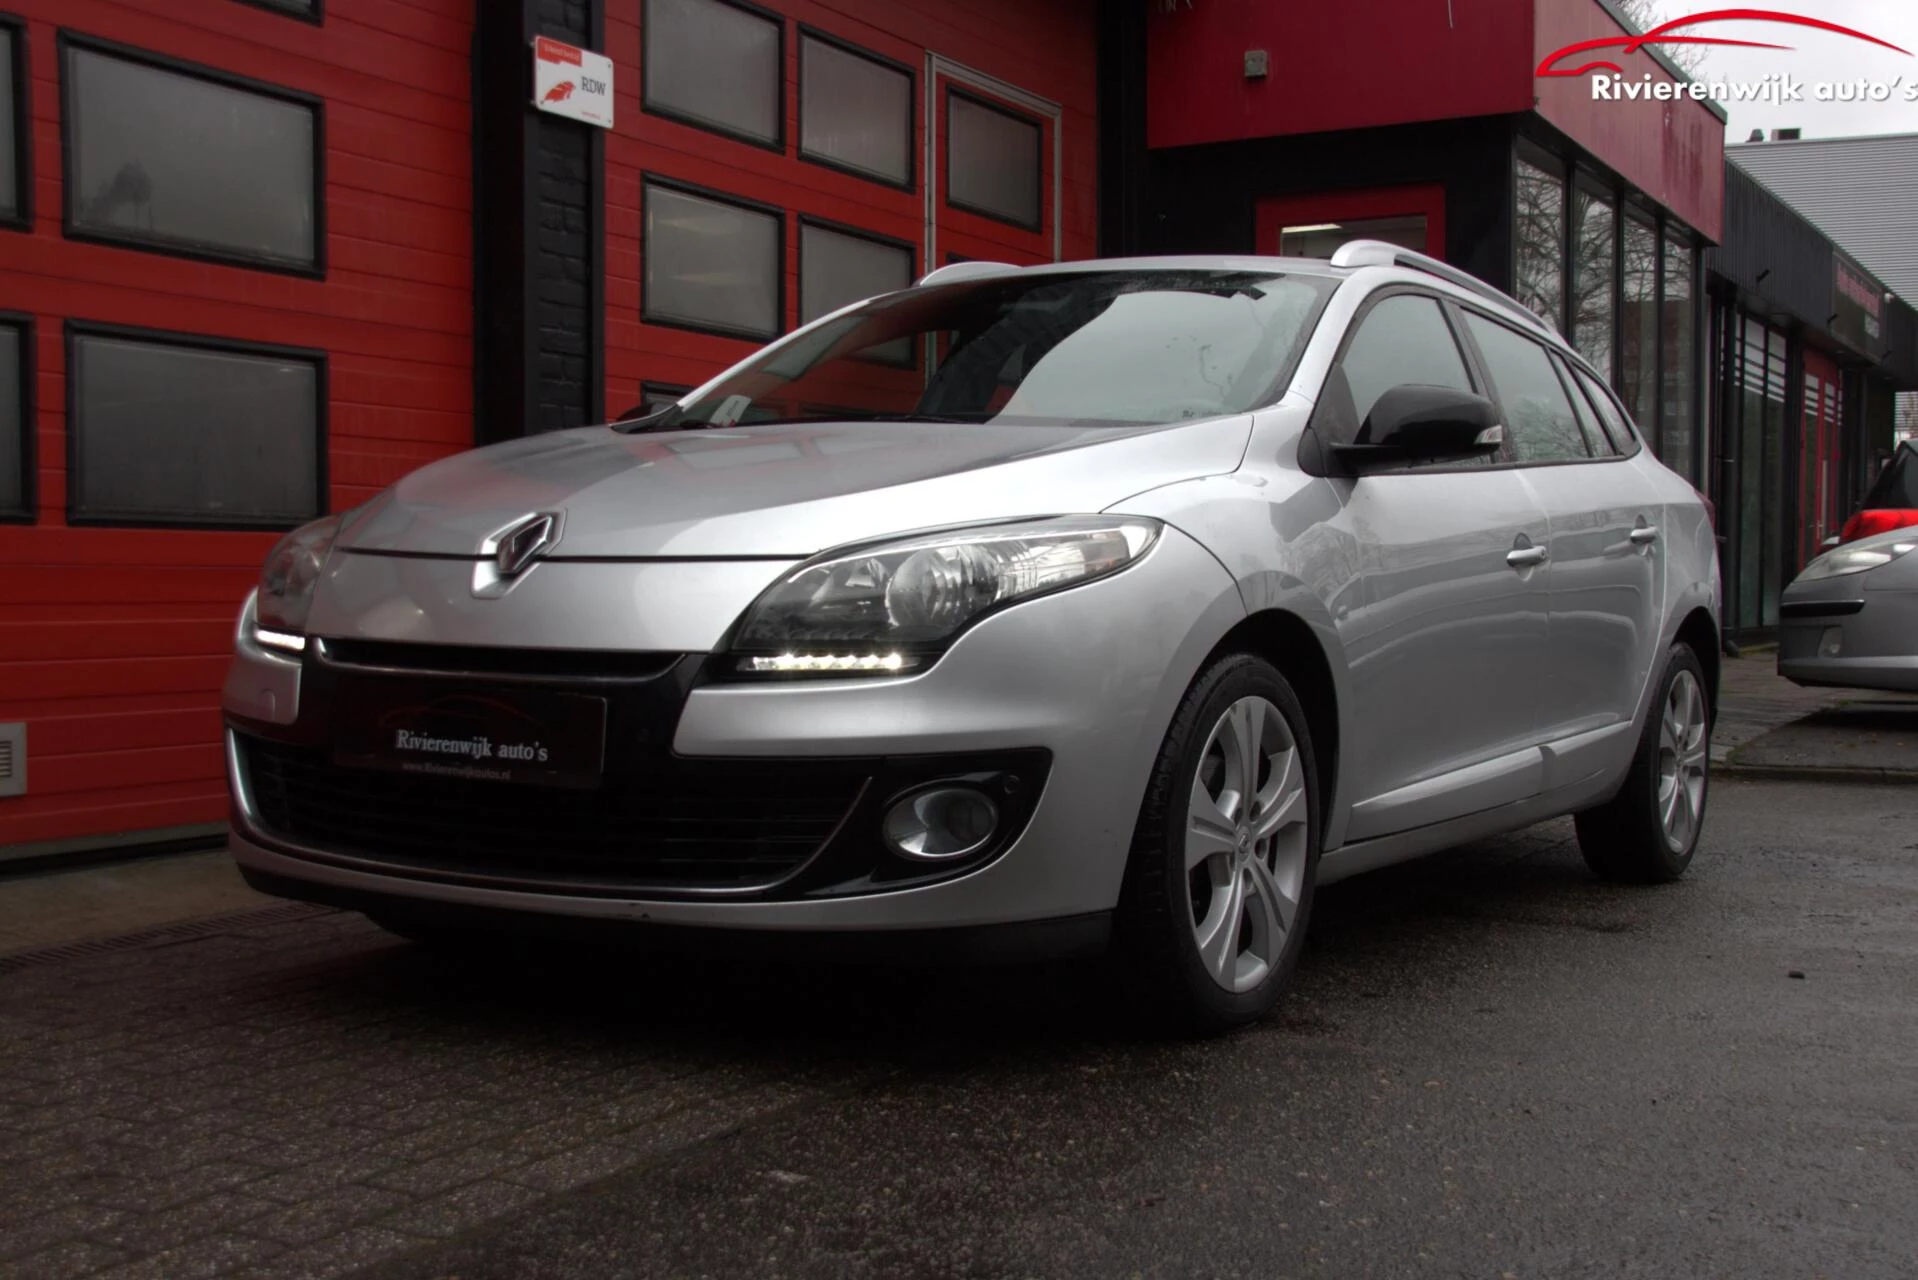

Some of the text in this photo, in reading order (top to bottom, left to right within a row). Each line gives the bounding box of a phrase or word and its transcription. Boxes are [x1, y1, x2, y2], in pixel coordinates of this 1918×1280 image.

[582, 76, 606, 96] RDW
[396, 729, 549, 761] Rivierenwijk auto's
